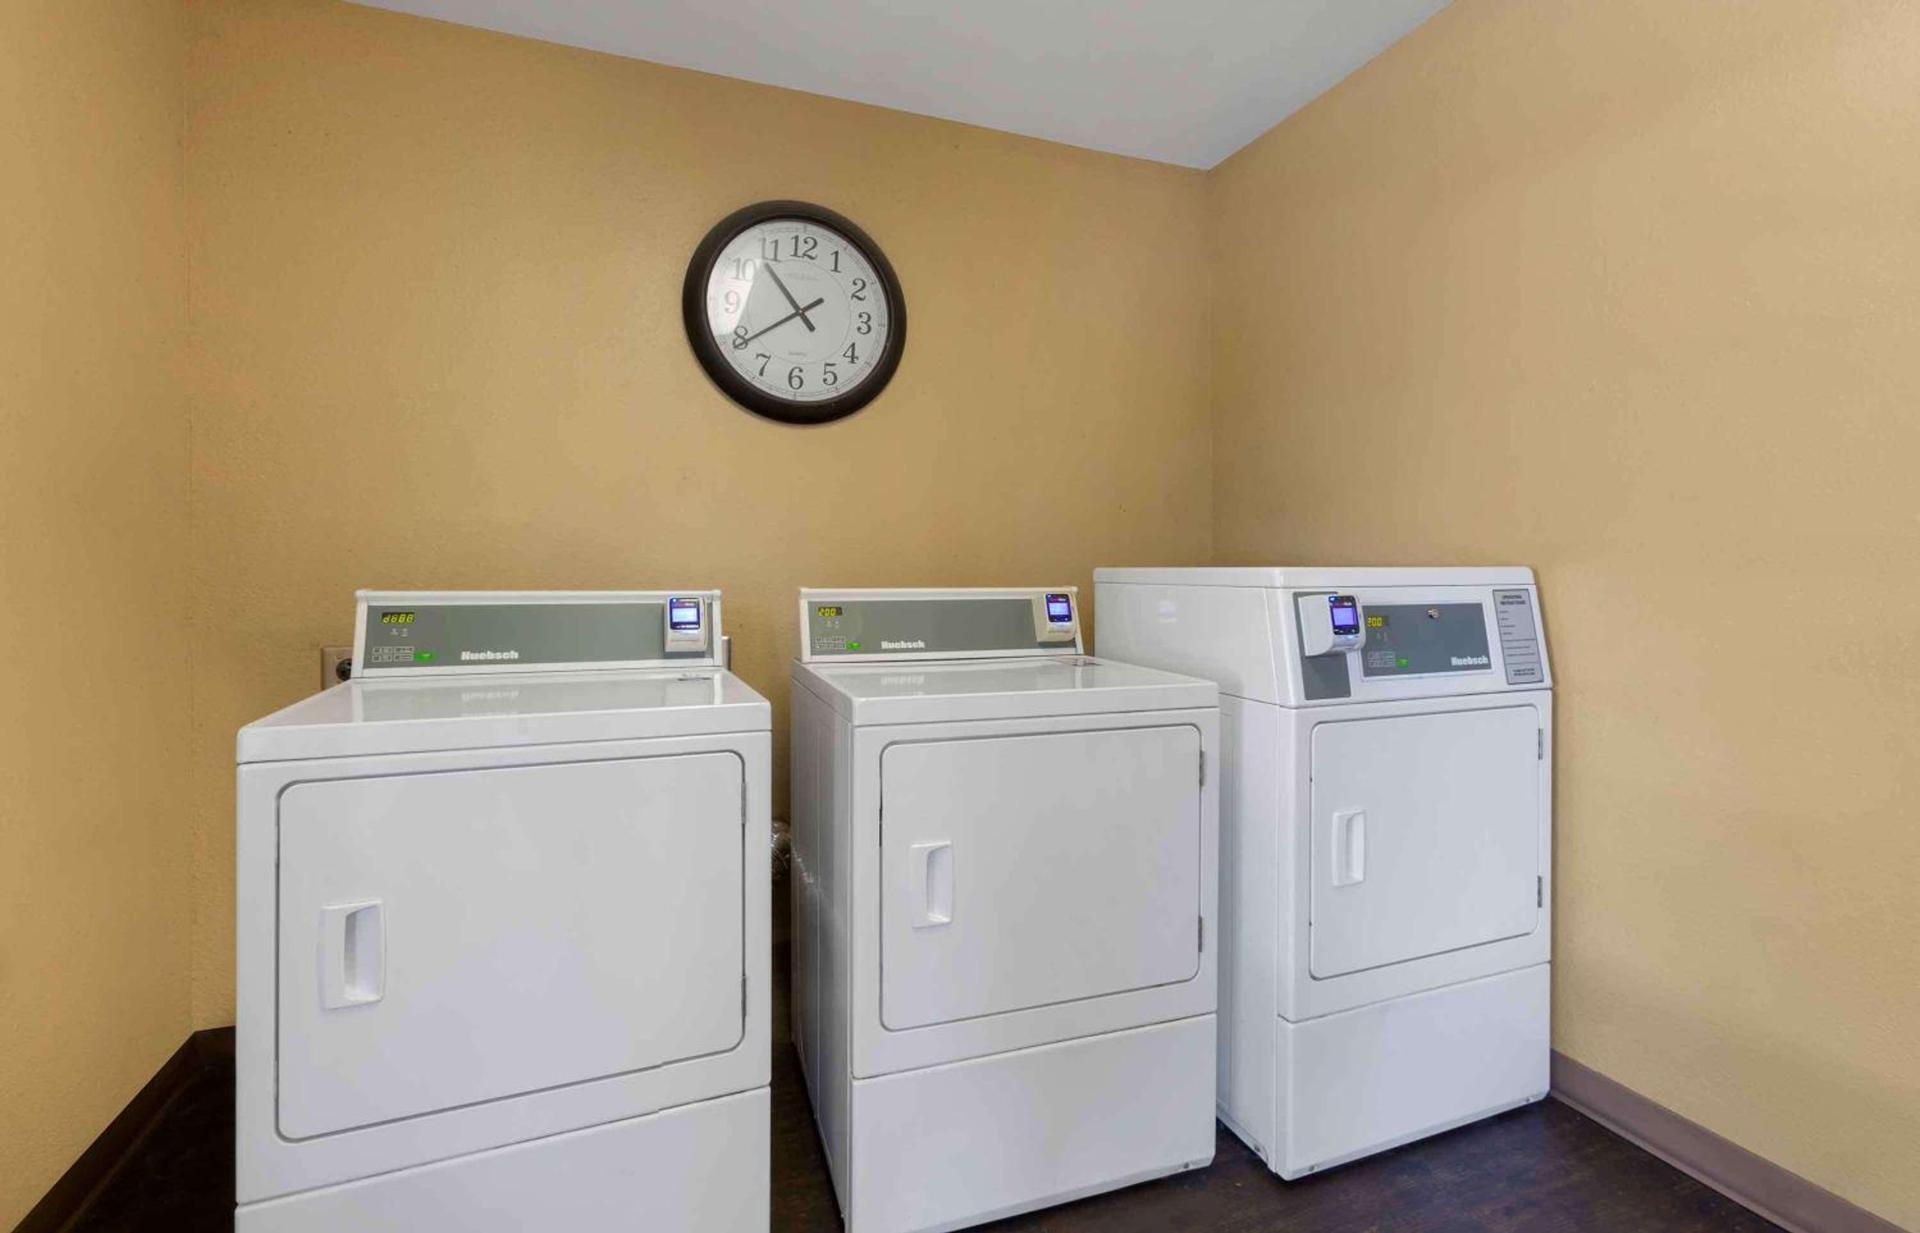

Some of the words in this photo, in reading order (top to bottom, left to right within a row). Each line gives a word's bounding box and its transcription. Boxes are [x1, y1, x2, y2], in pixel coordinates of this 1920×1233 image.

[760, 237, 781, 263] 11
[790, 235, 818, 260] 12
[732, 257, 756, 281] 10
[830, 250, 842, 273] 1
[850, 278, 867, 301] 2
[724, 291, 741, 314] 9
[857, 312, 872, 335] 3
[733, 325, 749, 350] 8
[843, 342, 859, 364] 4
[755, 353, 772, 377] 7
[822, 363, 838, 385] 5
[788, 366, 804, 390] 6
[460, 650, 519, 661] Huebsch
[881, 639, 925, 650] Huebsch
[1450, 655, 1489, 666] Huebsch
